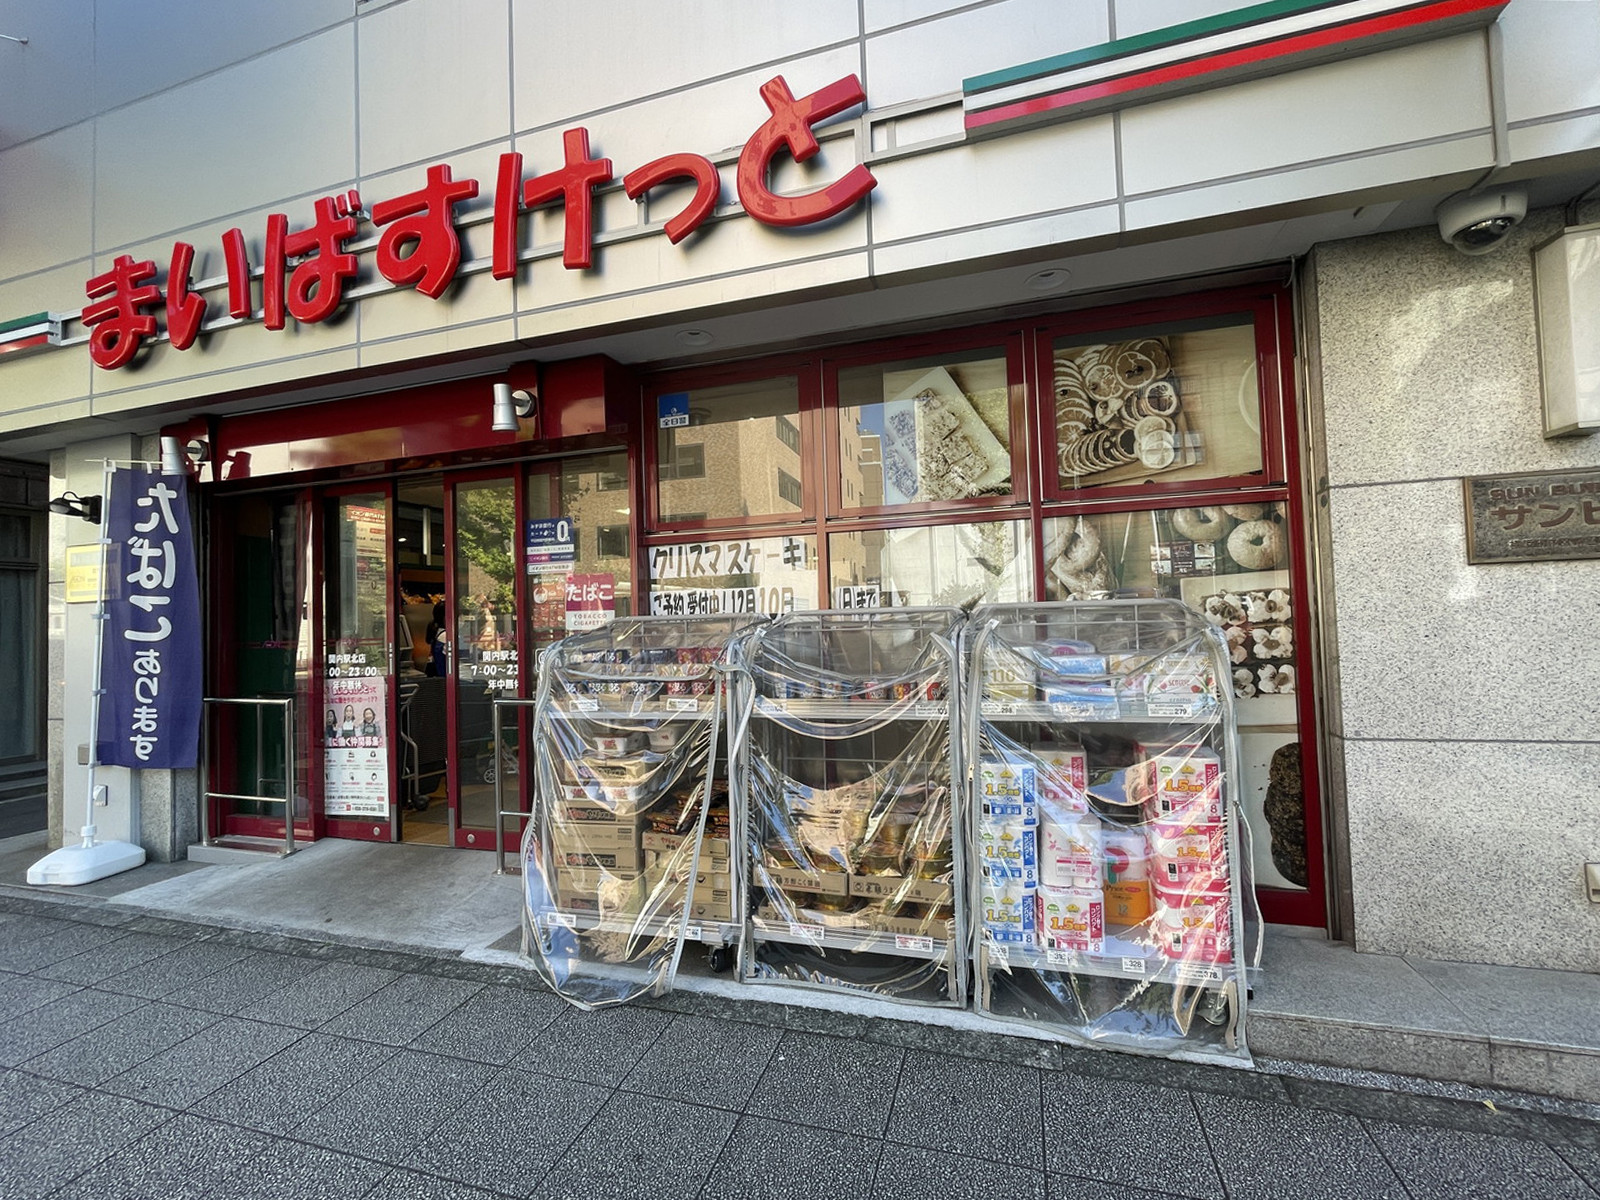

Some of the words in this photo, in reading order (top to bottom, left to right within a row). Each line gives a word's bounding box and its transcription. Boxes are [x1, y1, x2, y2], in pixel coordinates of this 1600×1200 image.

[82, 73, 877, 371] まいばすけっと
[653, 537, 802, 578] クリスマスケーキ
[567, 583, 613, 601] たばこ
[1210, 804, 1218, 814] 8
[1026, 869, 1034, 879] 8
[1026, 934, 1033, 944] 8
